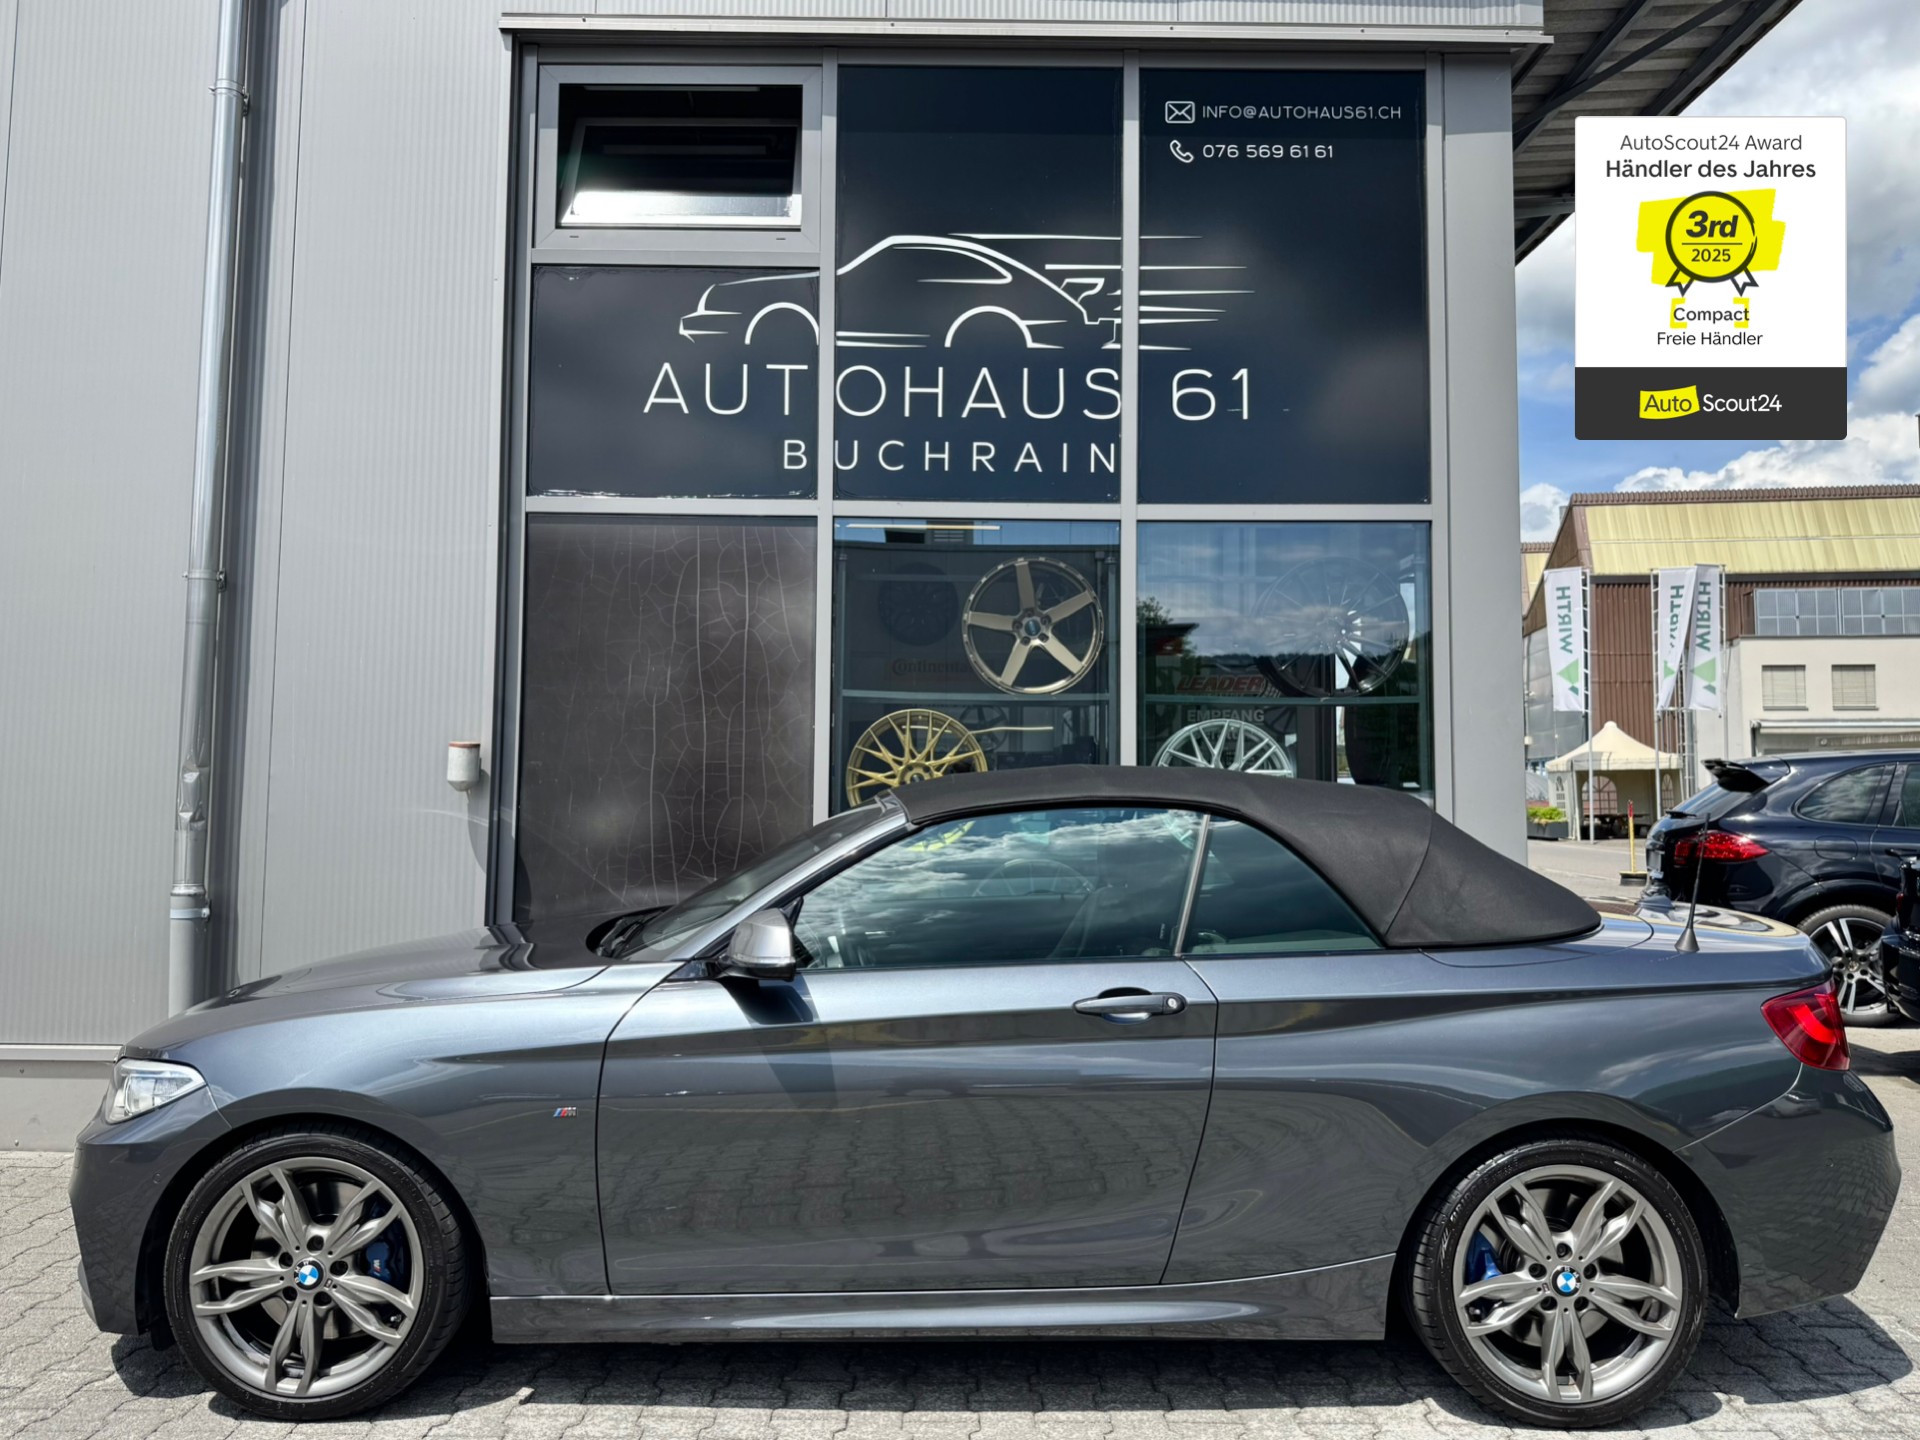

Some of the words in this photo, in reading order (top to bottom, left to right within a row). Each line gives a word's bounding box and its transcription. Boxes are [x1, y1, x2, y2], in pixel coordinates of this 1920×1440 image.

[1202, 105, 1401, 120] INFO@AUTOHAUS61.CH
[1202, 144, 1239, 158] 076
[1246, 144, 1284, 158] 569
[1290, 144, 1309, 158] 61
[1314, 145, 1333, 158] 61
[643, 362, 1121, 420] AUTOHAUS
[1172, 368, 1248, 421] 61
[783, 439, 1115, 473] BUCHRAIN
[1176, 674, 1265, 692] LEADER
[1187, 709, 1265, 722] EMPFANG
